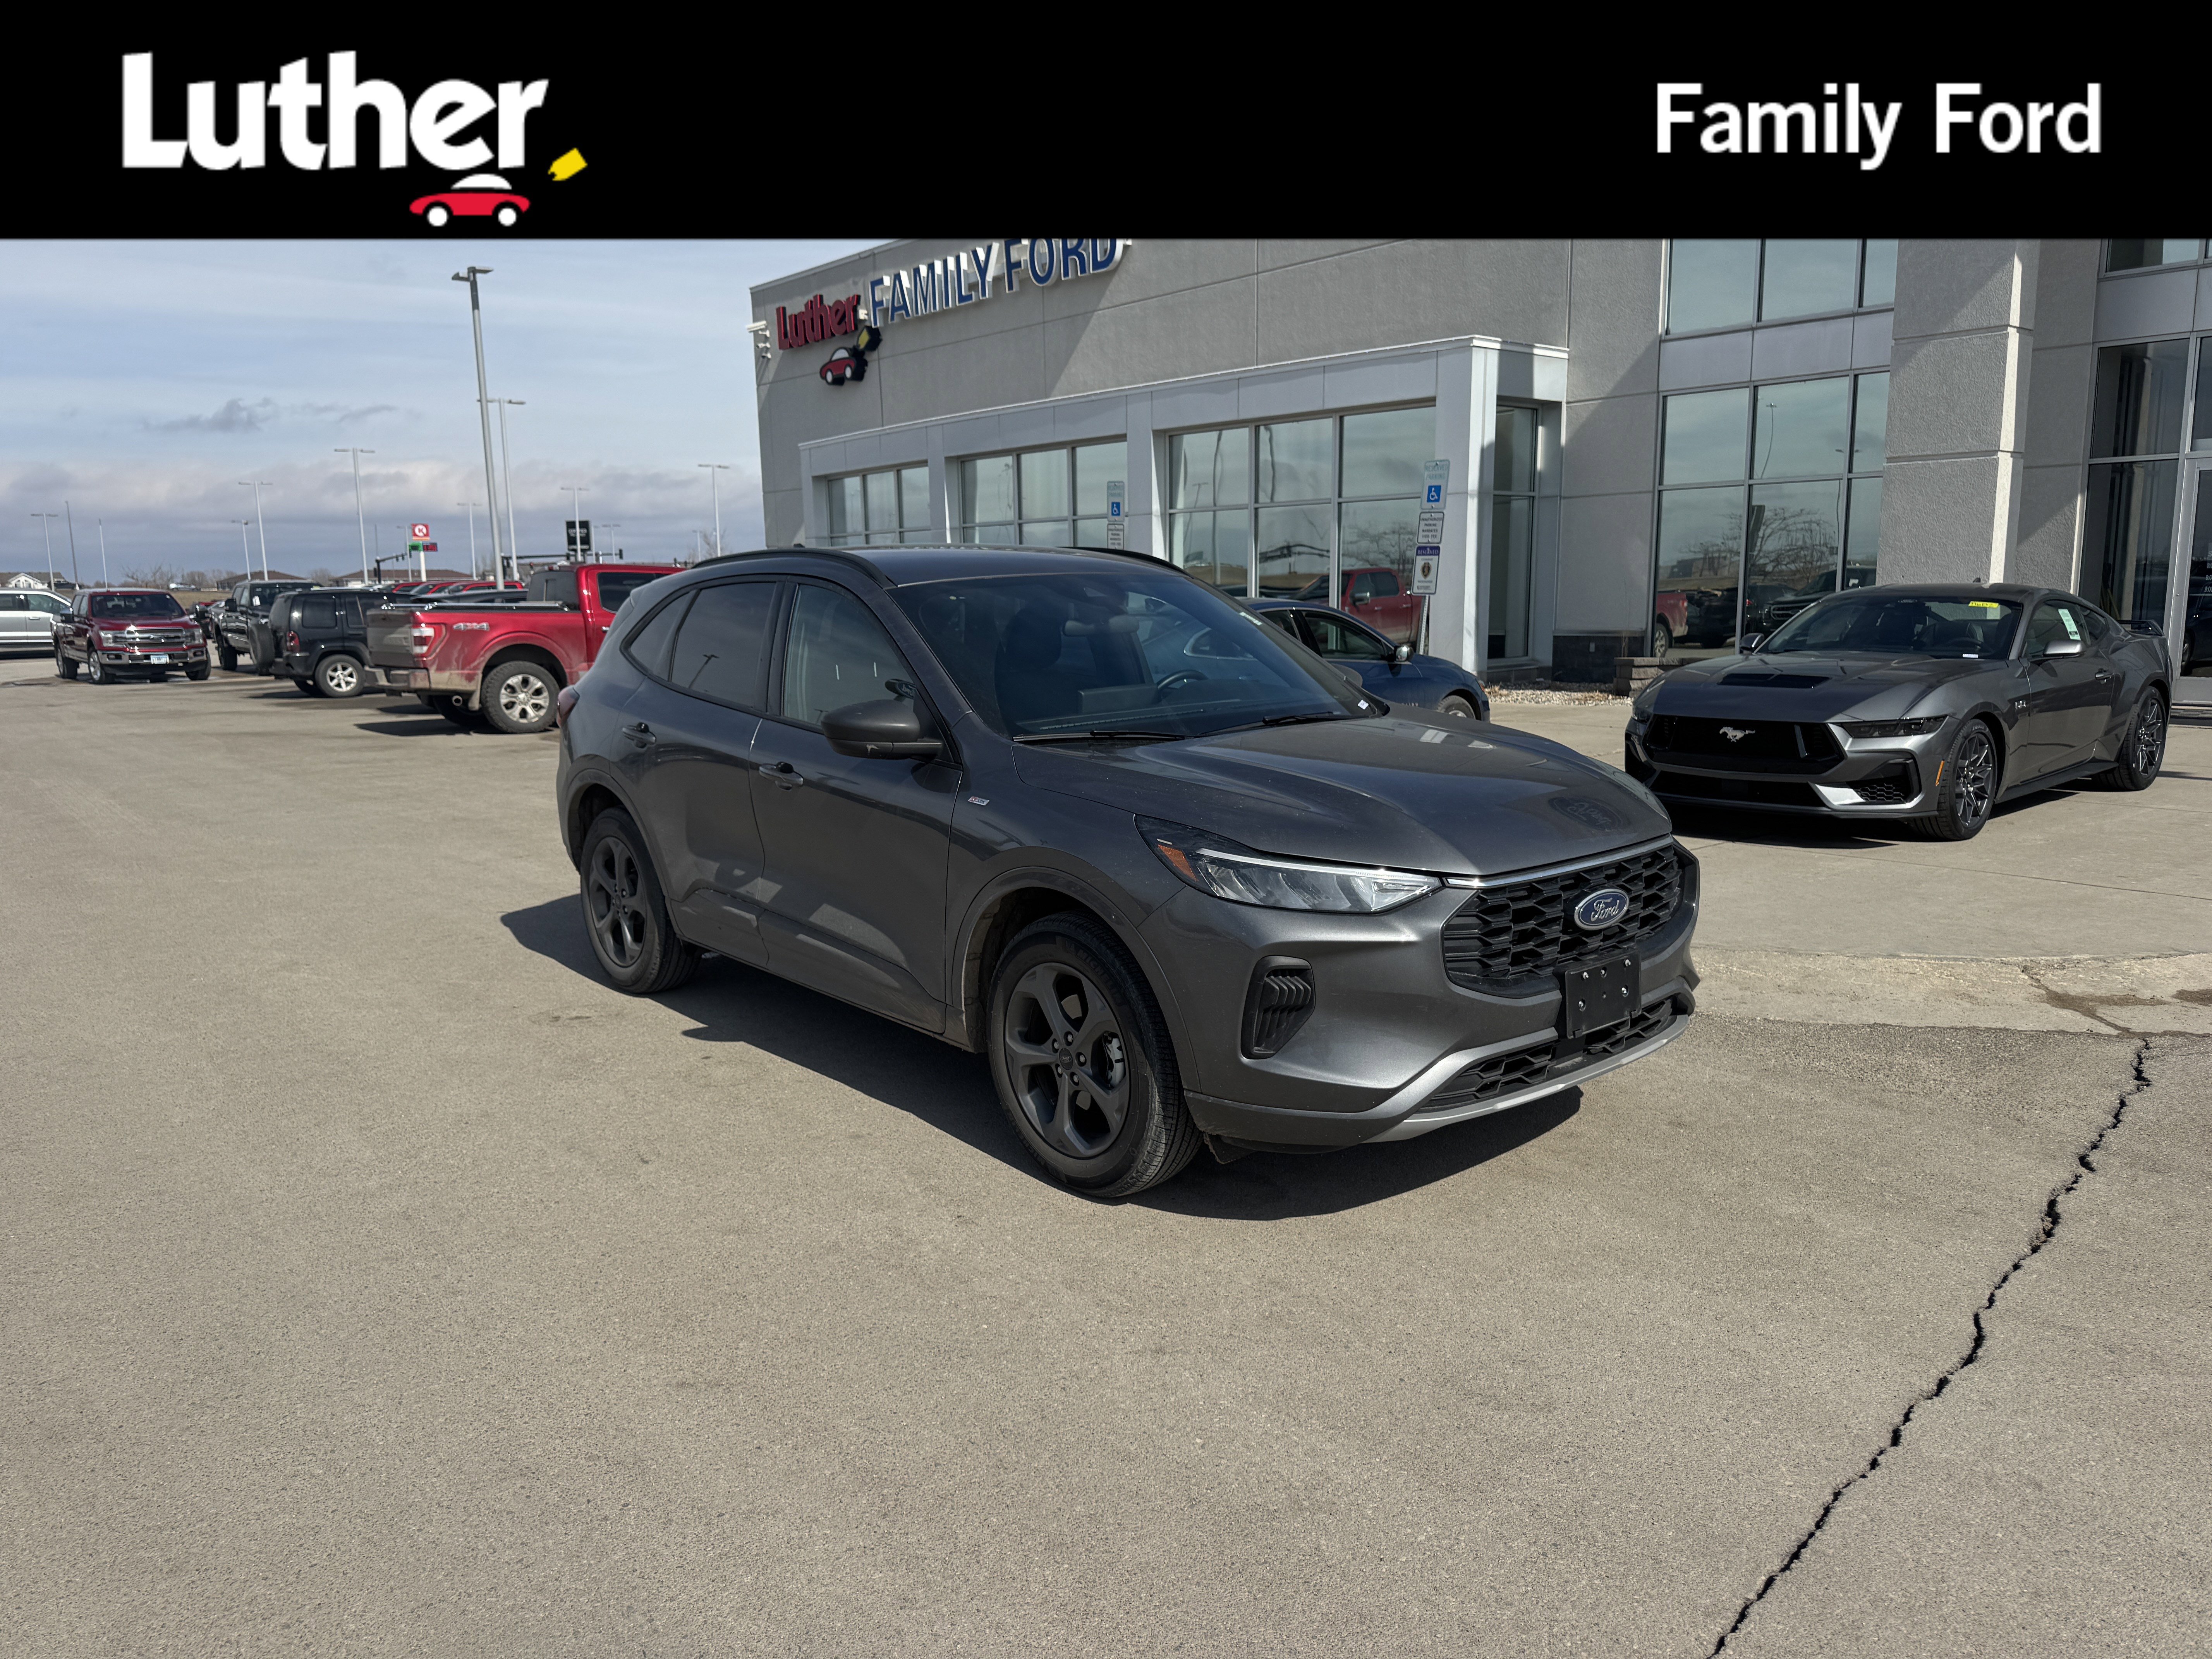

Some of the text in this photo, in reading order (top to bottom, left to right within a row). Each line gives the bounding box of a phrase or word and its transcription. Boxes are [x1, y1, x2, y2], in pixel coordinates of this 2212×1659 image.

[869, 239, 1123, 328] FAMILY FORD
[776, 294, 859, 349] Luther
[1590, 898, 1619, 922] Ford
